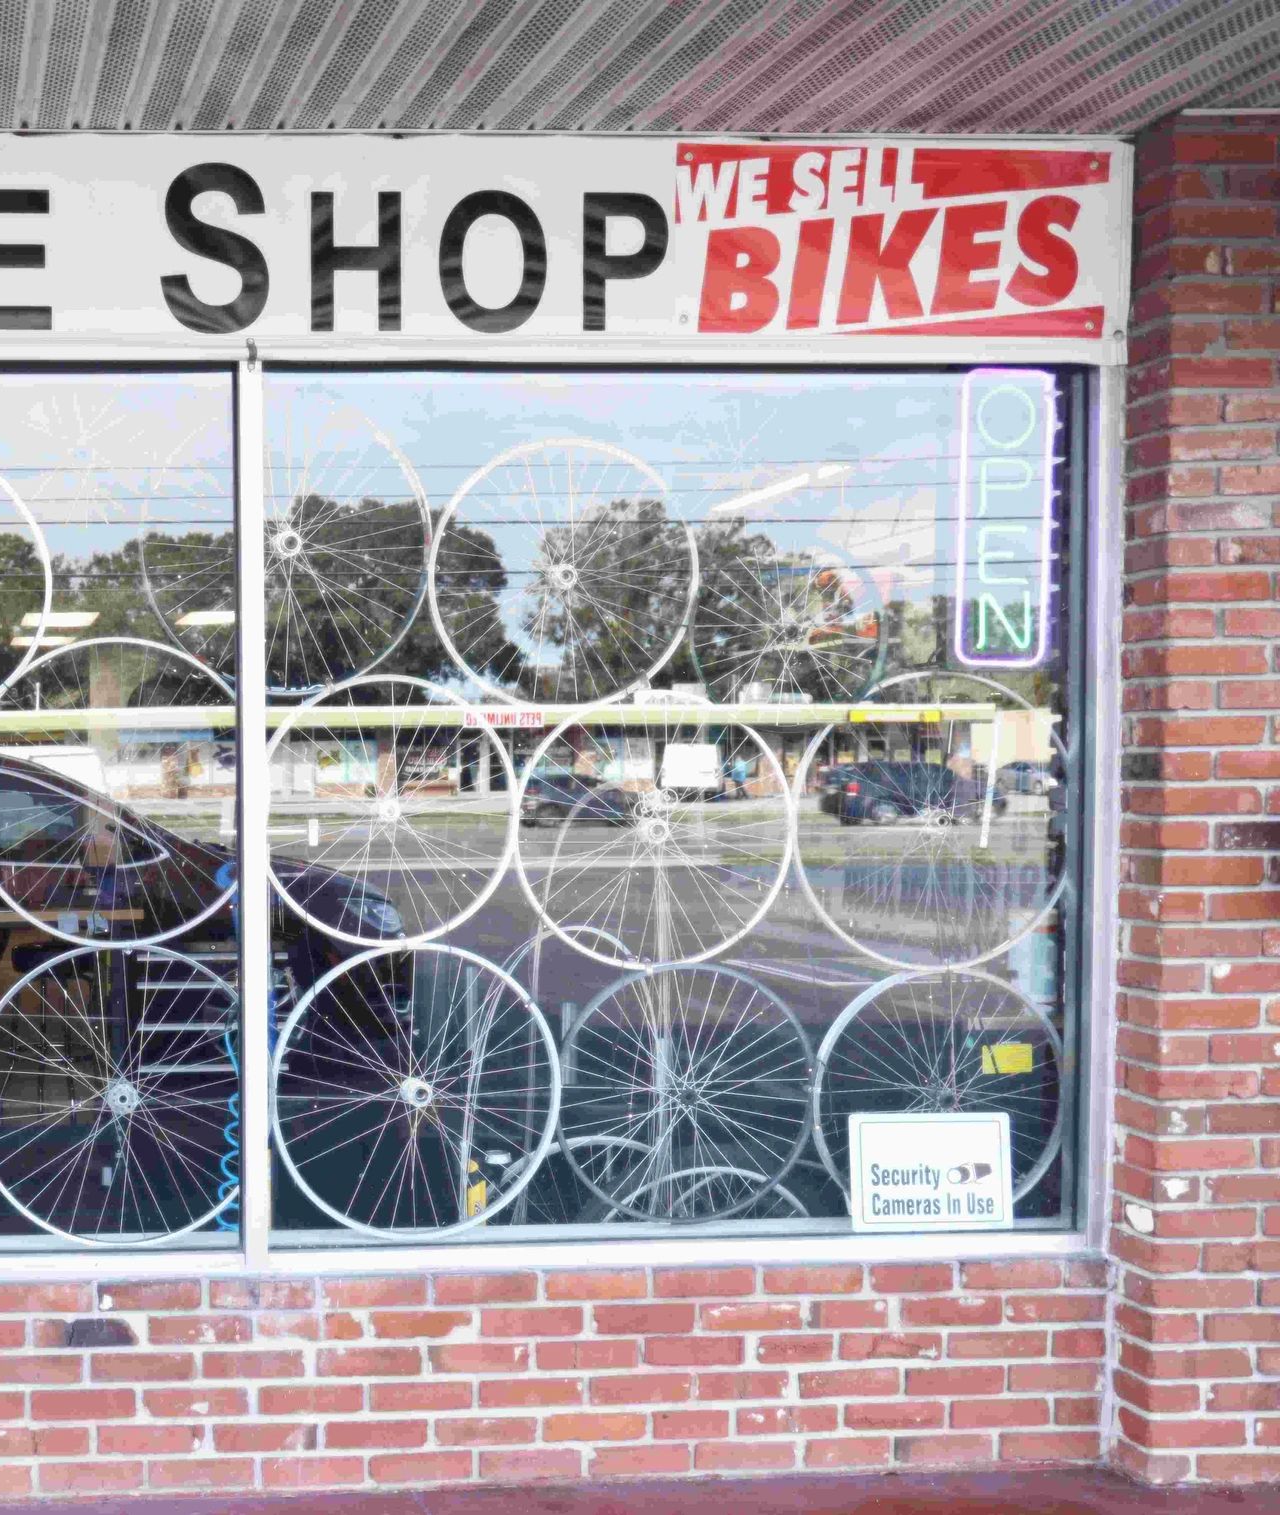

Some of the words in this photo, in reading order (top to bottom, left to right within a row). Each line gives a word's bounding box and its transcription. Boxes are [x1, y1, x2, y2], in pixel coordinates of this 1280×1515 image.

[675, 157, 774, 225] WE
[788, 147, 923, 214] SELL
[160, 162, 669, 334] SHOP
[697, 194, 1082, 334] BIKES
[976, 385, 1036, 651] OPEN
[871, 1162, 941, 1190] Security
[872, 1193, 941, 1216] Cameras
[947, 1193, 961, 1214] In
[967, 1193, 994, 1214] Use
